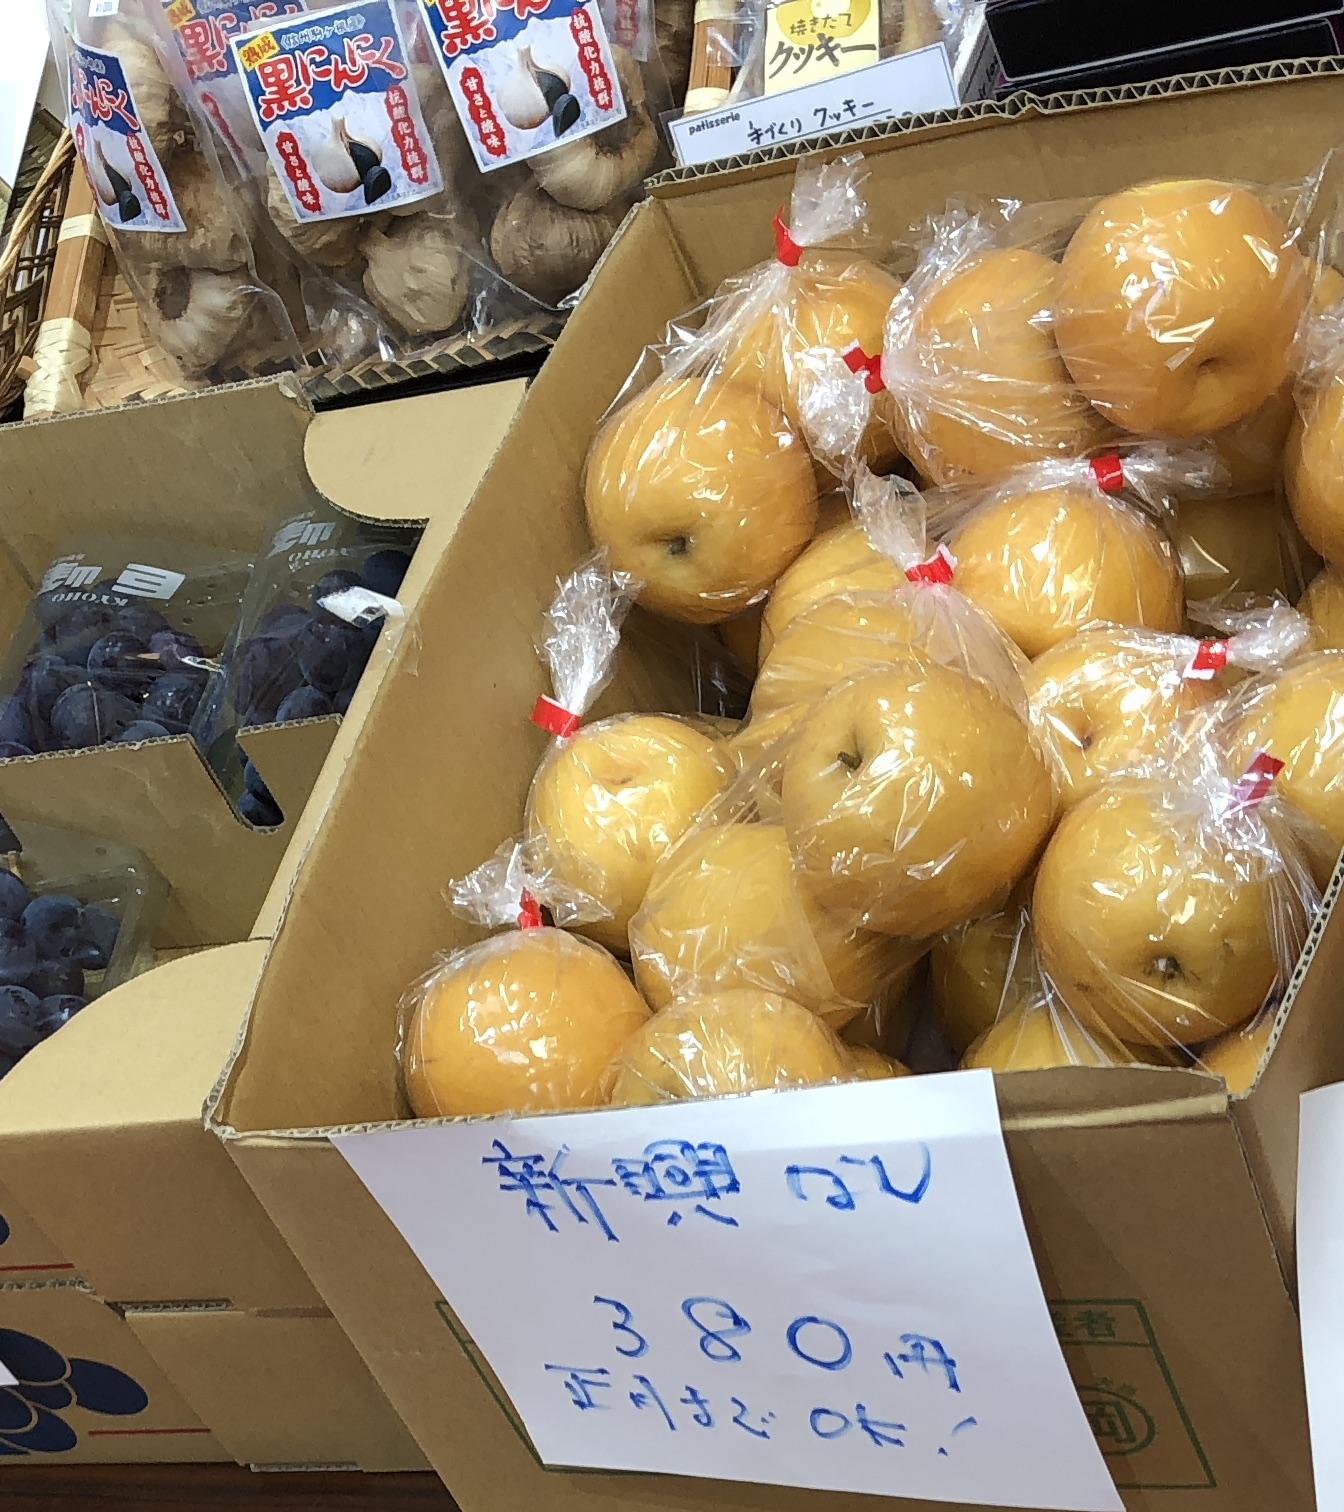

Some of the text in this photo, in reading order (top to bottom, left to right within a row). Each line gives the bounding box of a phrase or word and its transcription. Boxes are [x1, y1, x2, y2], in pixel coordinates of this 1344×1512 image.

[790, 13, 852, 35] 焼きたて
[257, 34, 408, 121] 黒にんにく
[769, 33, 877, 79] クッキー
[688, 111, 741, 136] patisserie
[747, 120, 803, 145] 手づくり
[813, 99, 875, 128] クッキー
[592, 1295, 961, 1392] 380円
